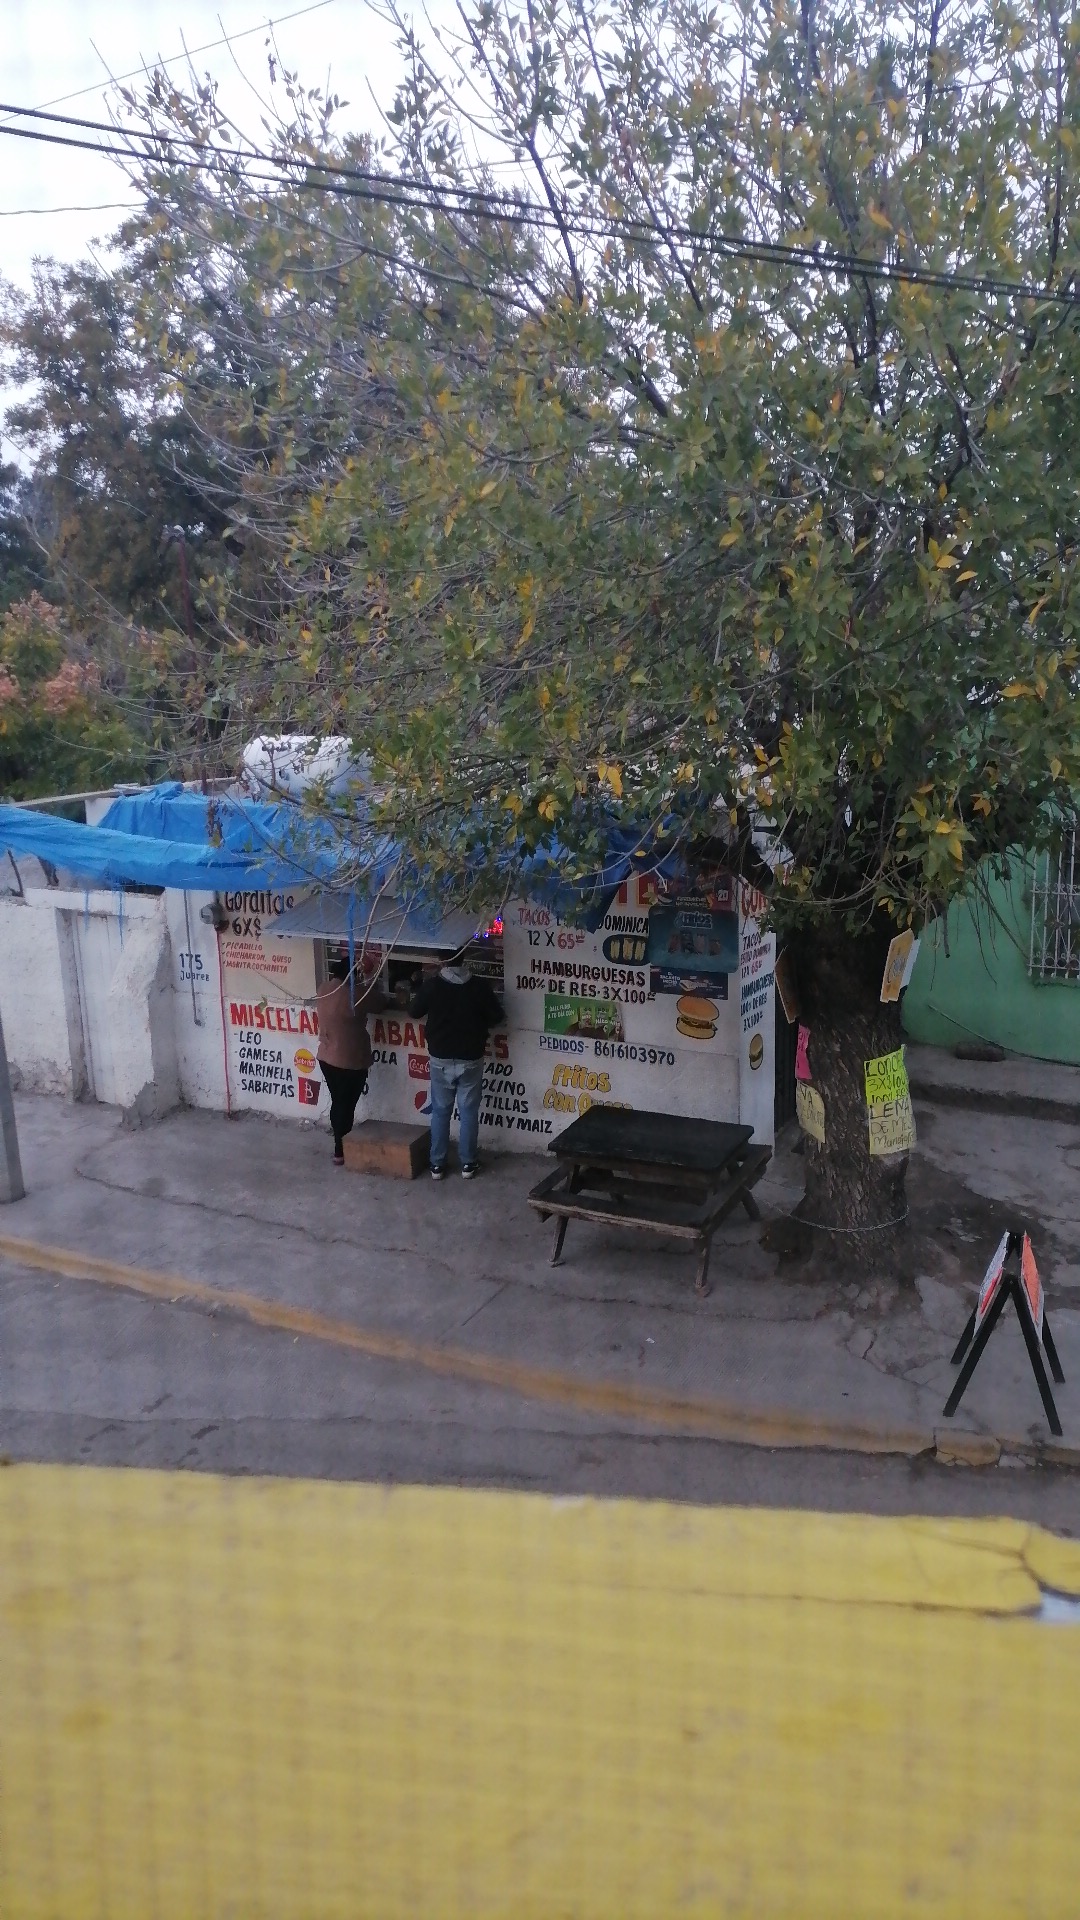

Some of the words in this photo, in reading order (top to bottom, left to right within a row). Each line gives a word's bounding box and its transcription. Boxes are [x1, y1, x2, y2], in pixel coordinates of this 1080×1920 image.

[517, 907, 551, 926] TACOS
[527, 930, 540, 946] 12
[545, 931, 555, 947] X
[180, 953, 203, 971] 175
[271, 954, 292, 964] QUESO
[530, 958, 646, 987] HAMBURGUESAS
[516, 974, 545, 990] 100%
[548, 979, 565, 994] DE
[240, 1031, 261, 1045] LEO
[239, 1047, 282, 1063] GAMESA
[373, 1050, 398, 1065] OLA
[594, 1040, 675, 1066] 8616103970
[239, 1061, 293, 1081] MARINELA
[484, 1061, 513, 1077] ADO
[552, 1063, 612, 1093] Fritos
[241, 1079, 295, 1098] SABRITAS
[482, 1094, 529, 1114] TILLAS
[543, 1088, 575, 1113] Con
